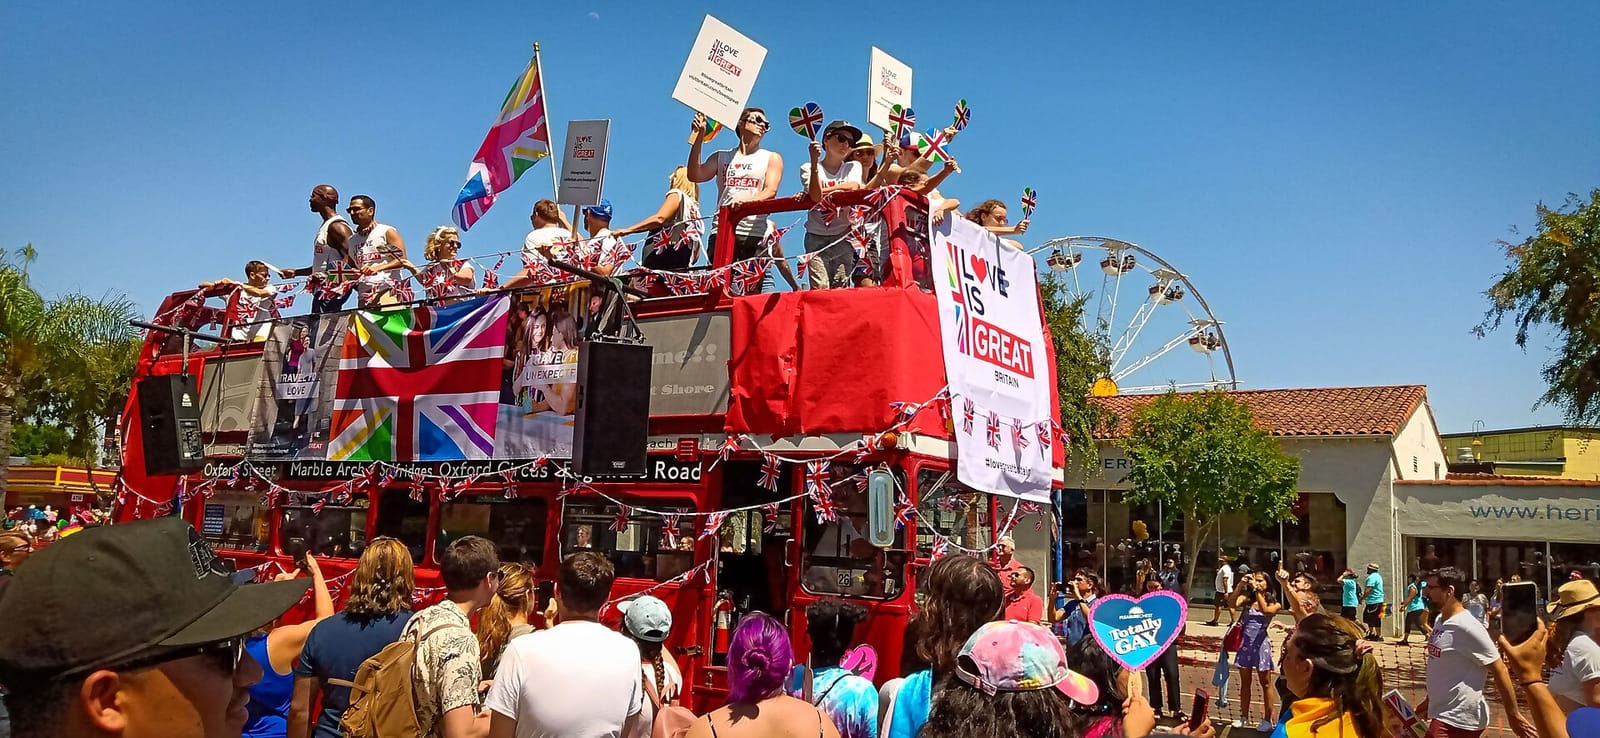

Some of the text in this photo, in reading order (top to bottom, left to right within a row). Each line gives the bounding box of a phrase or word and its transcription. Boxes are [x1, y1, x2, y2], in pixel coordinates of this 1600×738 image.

[716, 48, 725, 57] IS
[714, 56, 741, 76] GREAT
[729, 178, 758, 187] GREAT
[965, 283, 985, 316] IS
[973, 323, 1033, 375] GREAT
[994, 370, 1019, 388] BRITAIN
[286, 386, 306, 396] LOVE
[661, 384, 715, 396] Shore
[647, 438, 673, 449] ach
[204, 461, 237, 477] Oxfor
[290, 462, 333, 477] Marble
[336, 462, 364, 477] Arch
[440, 461, 492, 478] Oxford
[498, 460, 548, 479] Circus
[654, 460, 702, 481] Road
[1470, 504, 1600, 521] www.heri
[838, 573, 850, 586] 26
[1111, 618, 1162, 641] Totally
[1114, 629, 1158, 655] GAY
